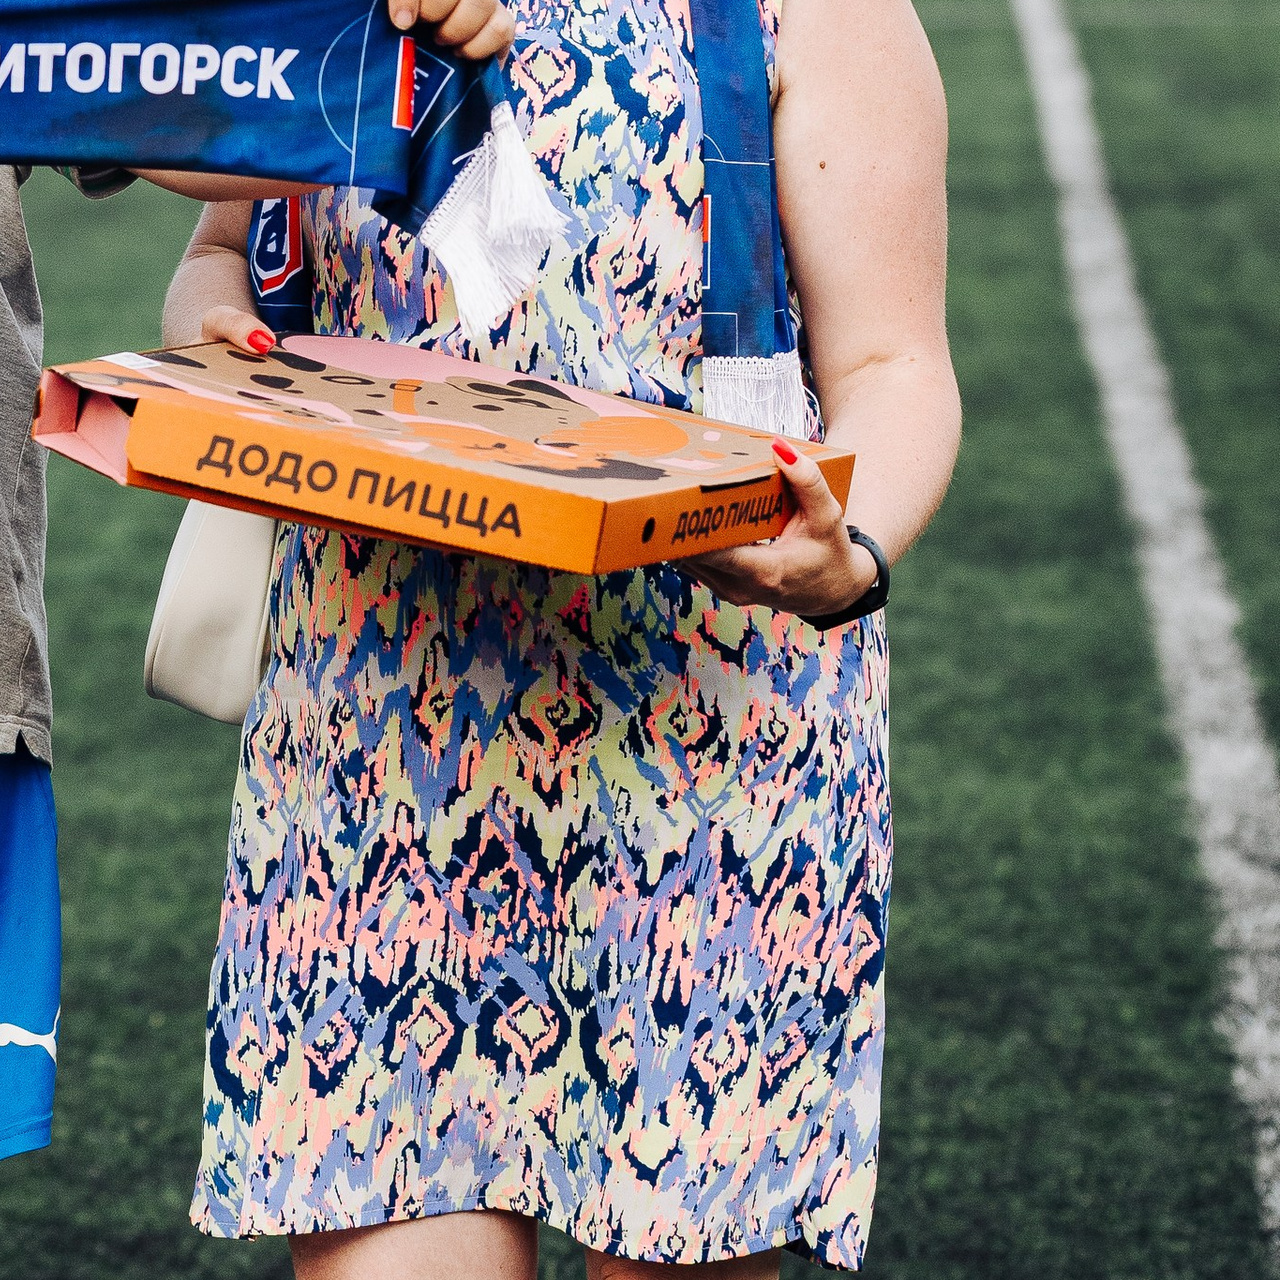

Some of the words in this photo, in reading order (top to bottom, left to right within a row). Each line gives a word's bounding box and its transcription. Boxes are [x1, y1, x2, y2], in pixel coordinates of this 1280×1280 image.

[196, 435, 338, 494] ДОДО
[348, 468, 522, 538] ПИЦЦА
[671, 505, 724, 545] ДОДО
[724, 492, 783, 529] ПИЦЦА
